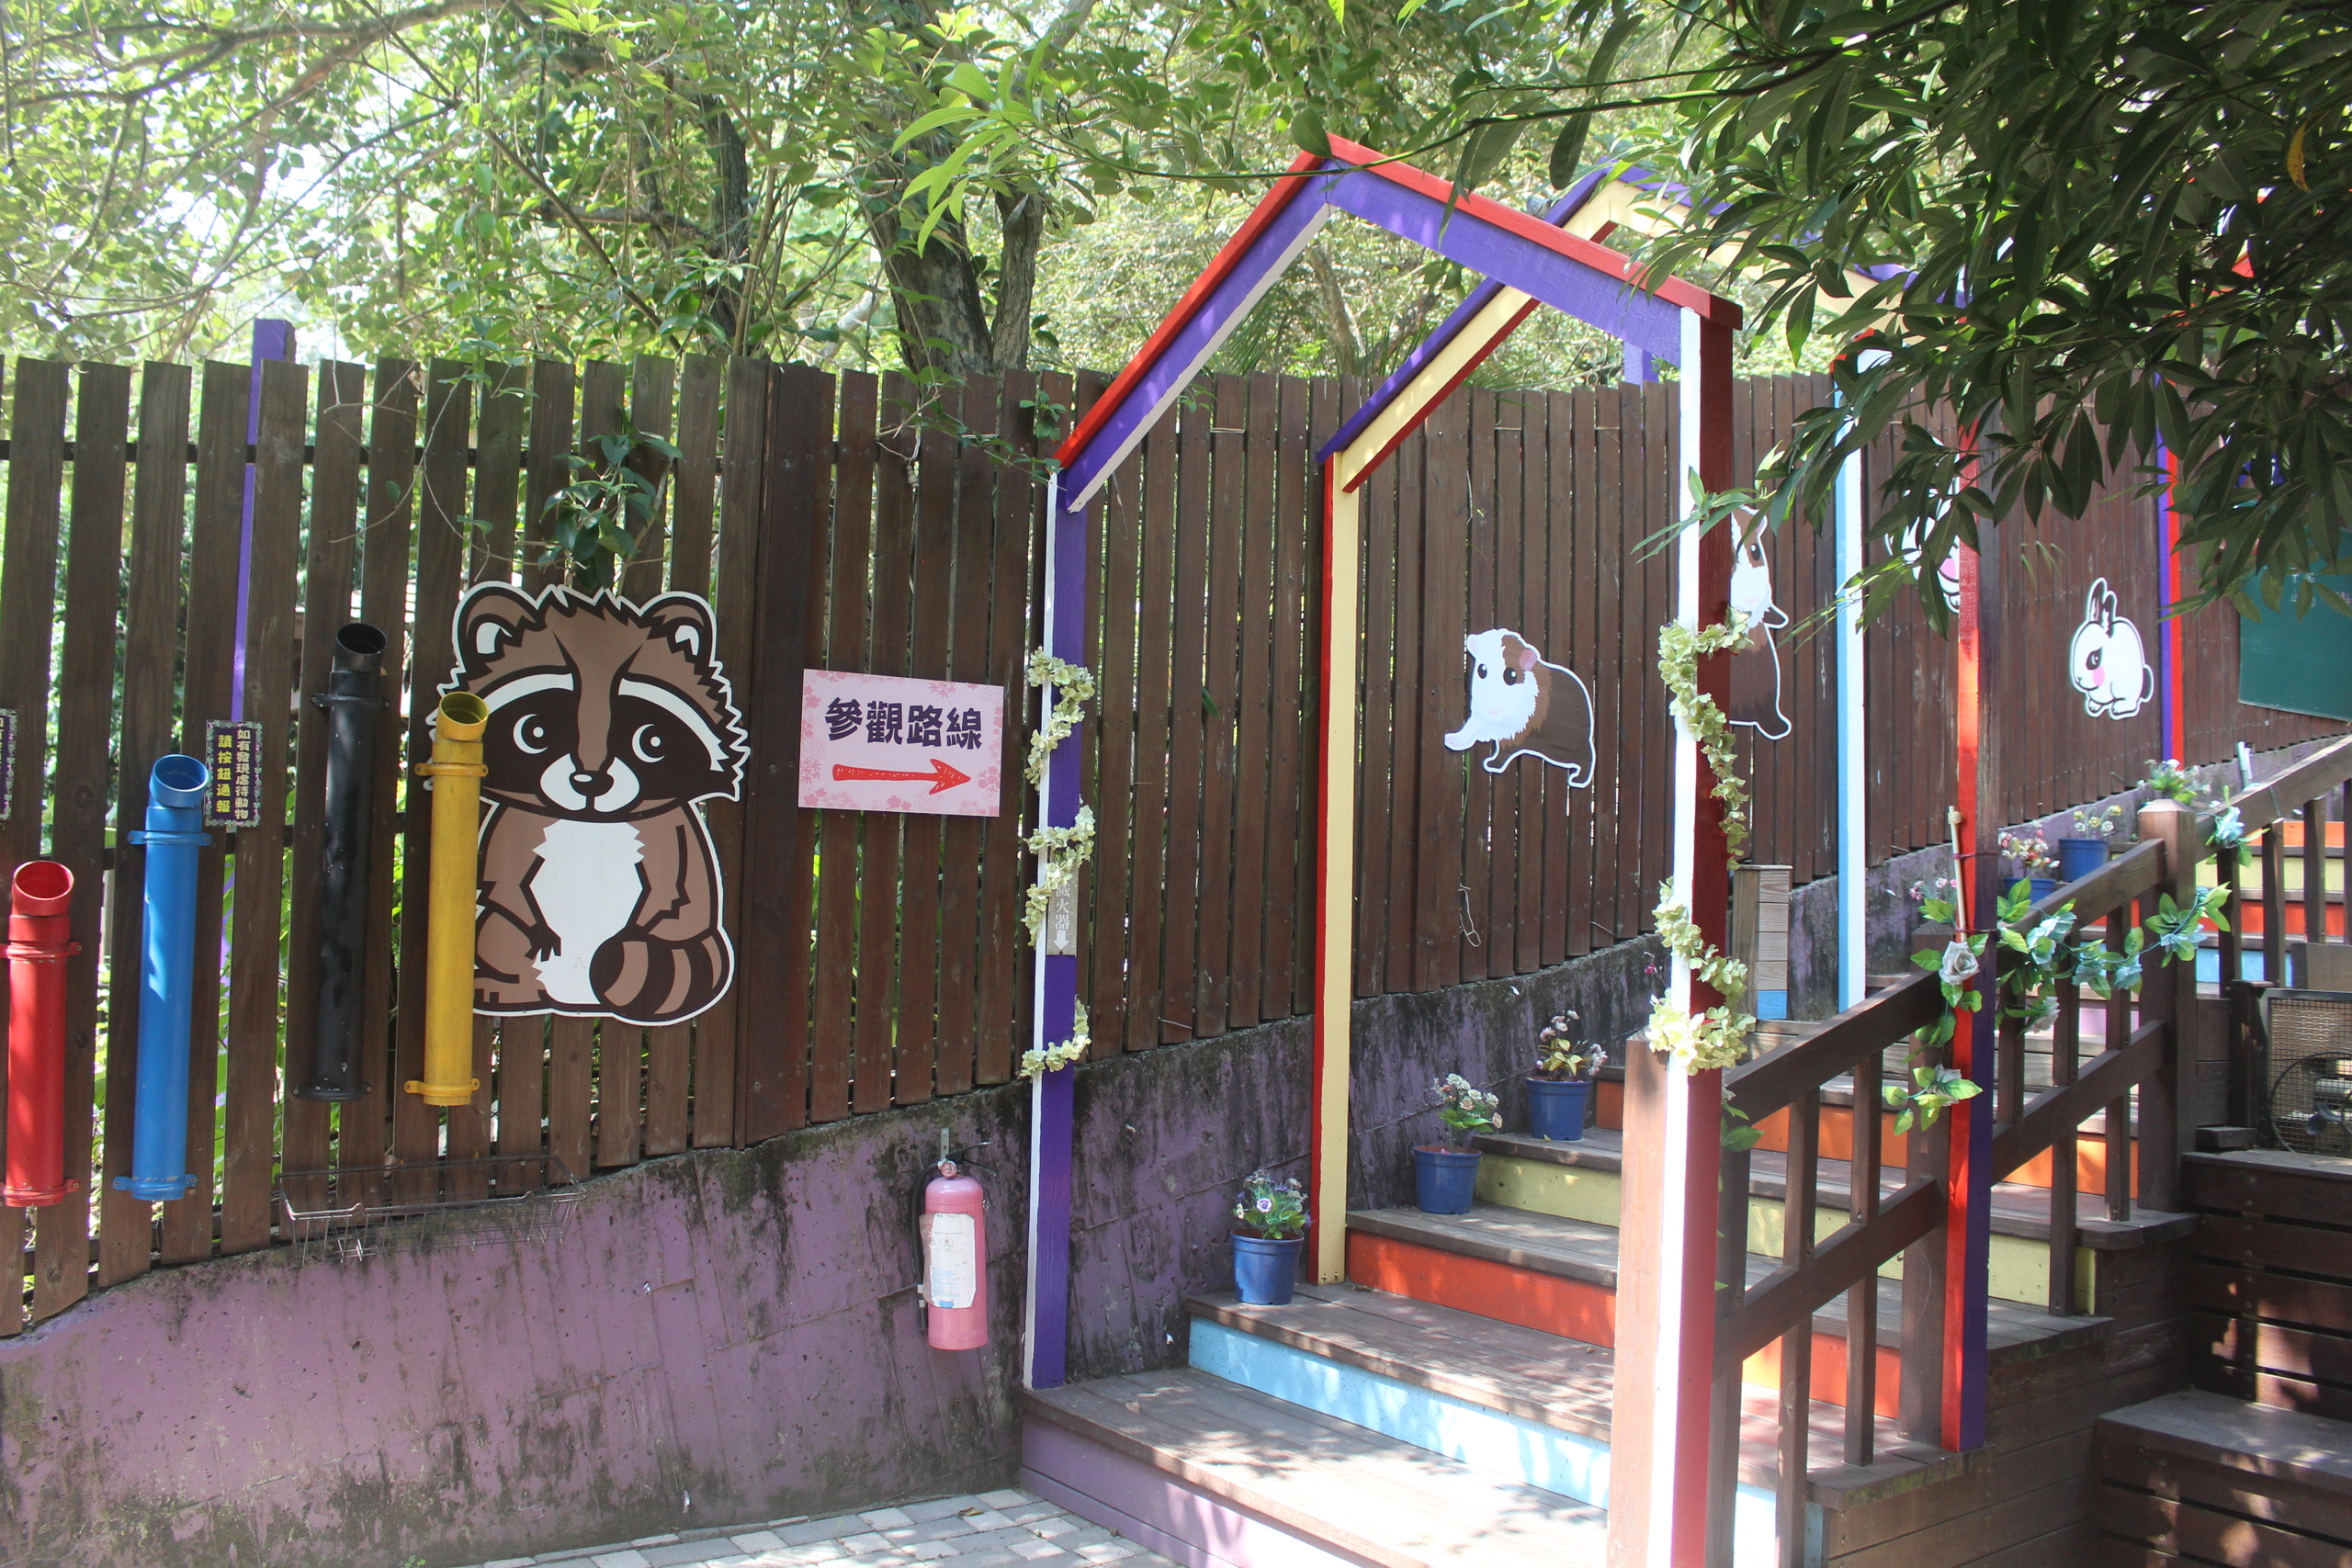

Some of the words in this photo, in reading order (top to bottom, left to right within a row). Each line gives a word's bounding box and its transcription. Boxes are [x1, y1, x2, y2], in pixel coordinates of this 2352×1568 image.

[824, 697, 982, 750] 參觀路線
[217, 735, 232, 813] 請按鈕通報
[234, 729, 251, 819] 如有發現虐待動物
[1055, 883, 1070, 930] 滅火器
